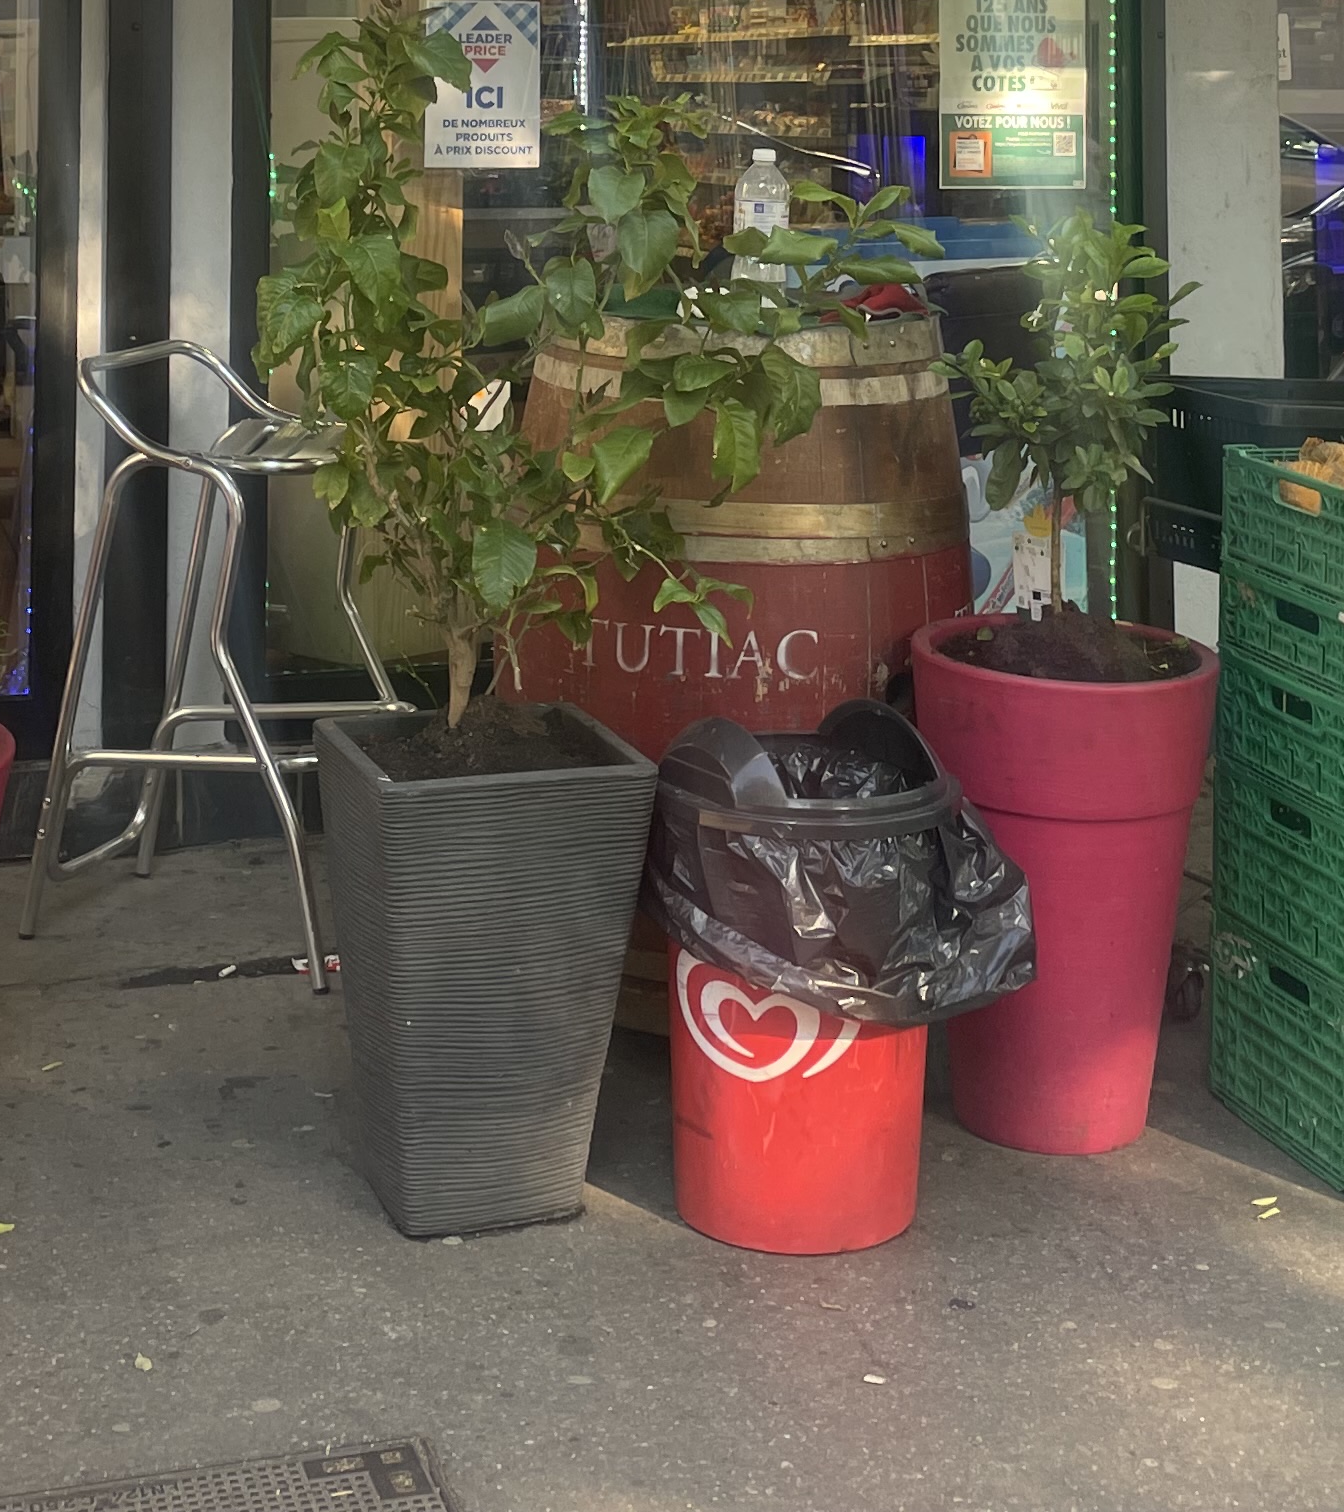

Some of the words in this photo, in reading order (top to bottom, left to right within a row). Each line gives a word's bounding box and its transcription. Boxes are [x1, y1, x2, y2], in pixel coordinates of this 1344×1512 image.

[966, 15, 1002, 34] QUE
[1007, 16, 1056, 34] NOUS
[459, 33, 513, 44] LEADER
[955, 34, 1035, 53] SOMMES
[464, 46, 506, 56] PRICE
[989, 55, 1026, 72] VOS
[466, 86, 504, 109] ICI
[443, 119, 458, 128] DE
[461, 119, 526, 128] NOMBREUX
[954, 116, 992, 128] VOTEZ
[996, 116, 1029, 128] POUR
[1030, 116, 1064, 128] NOUS
[456, 133, 513, 142] PRODUITS
[434, 144, 443, 155] À
[446, 146, 472, 155] PRIX
[475, 145, 533, 155] DISCOUNT
[582, 617, 819, 681] TUTIAC
